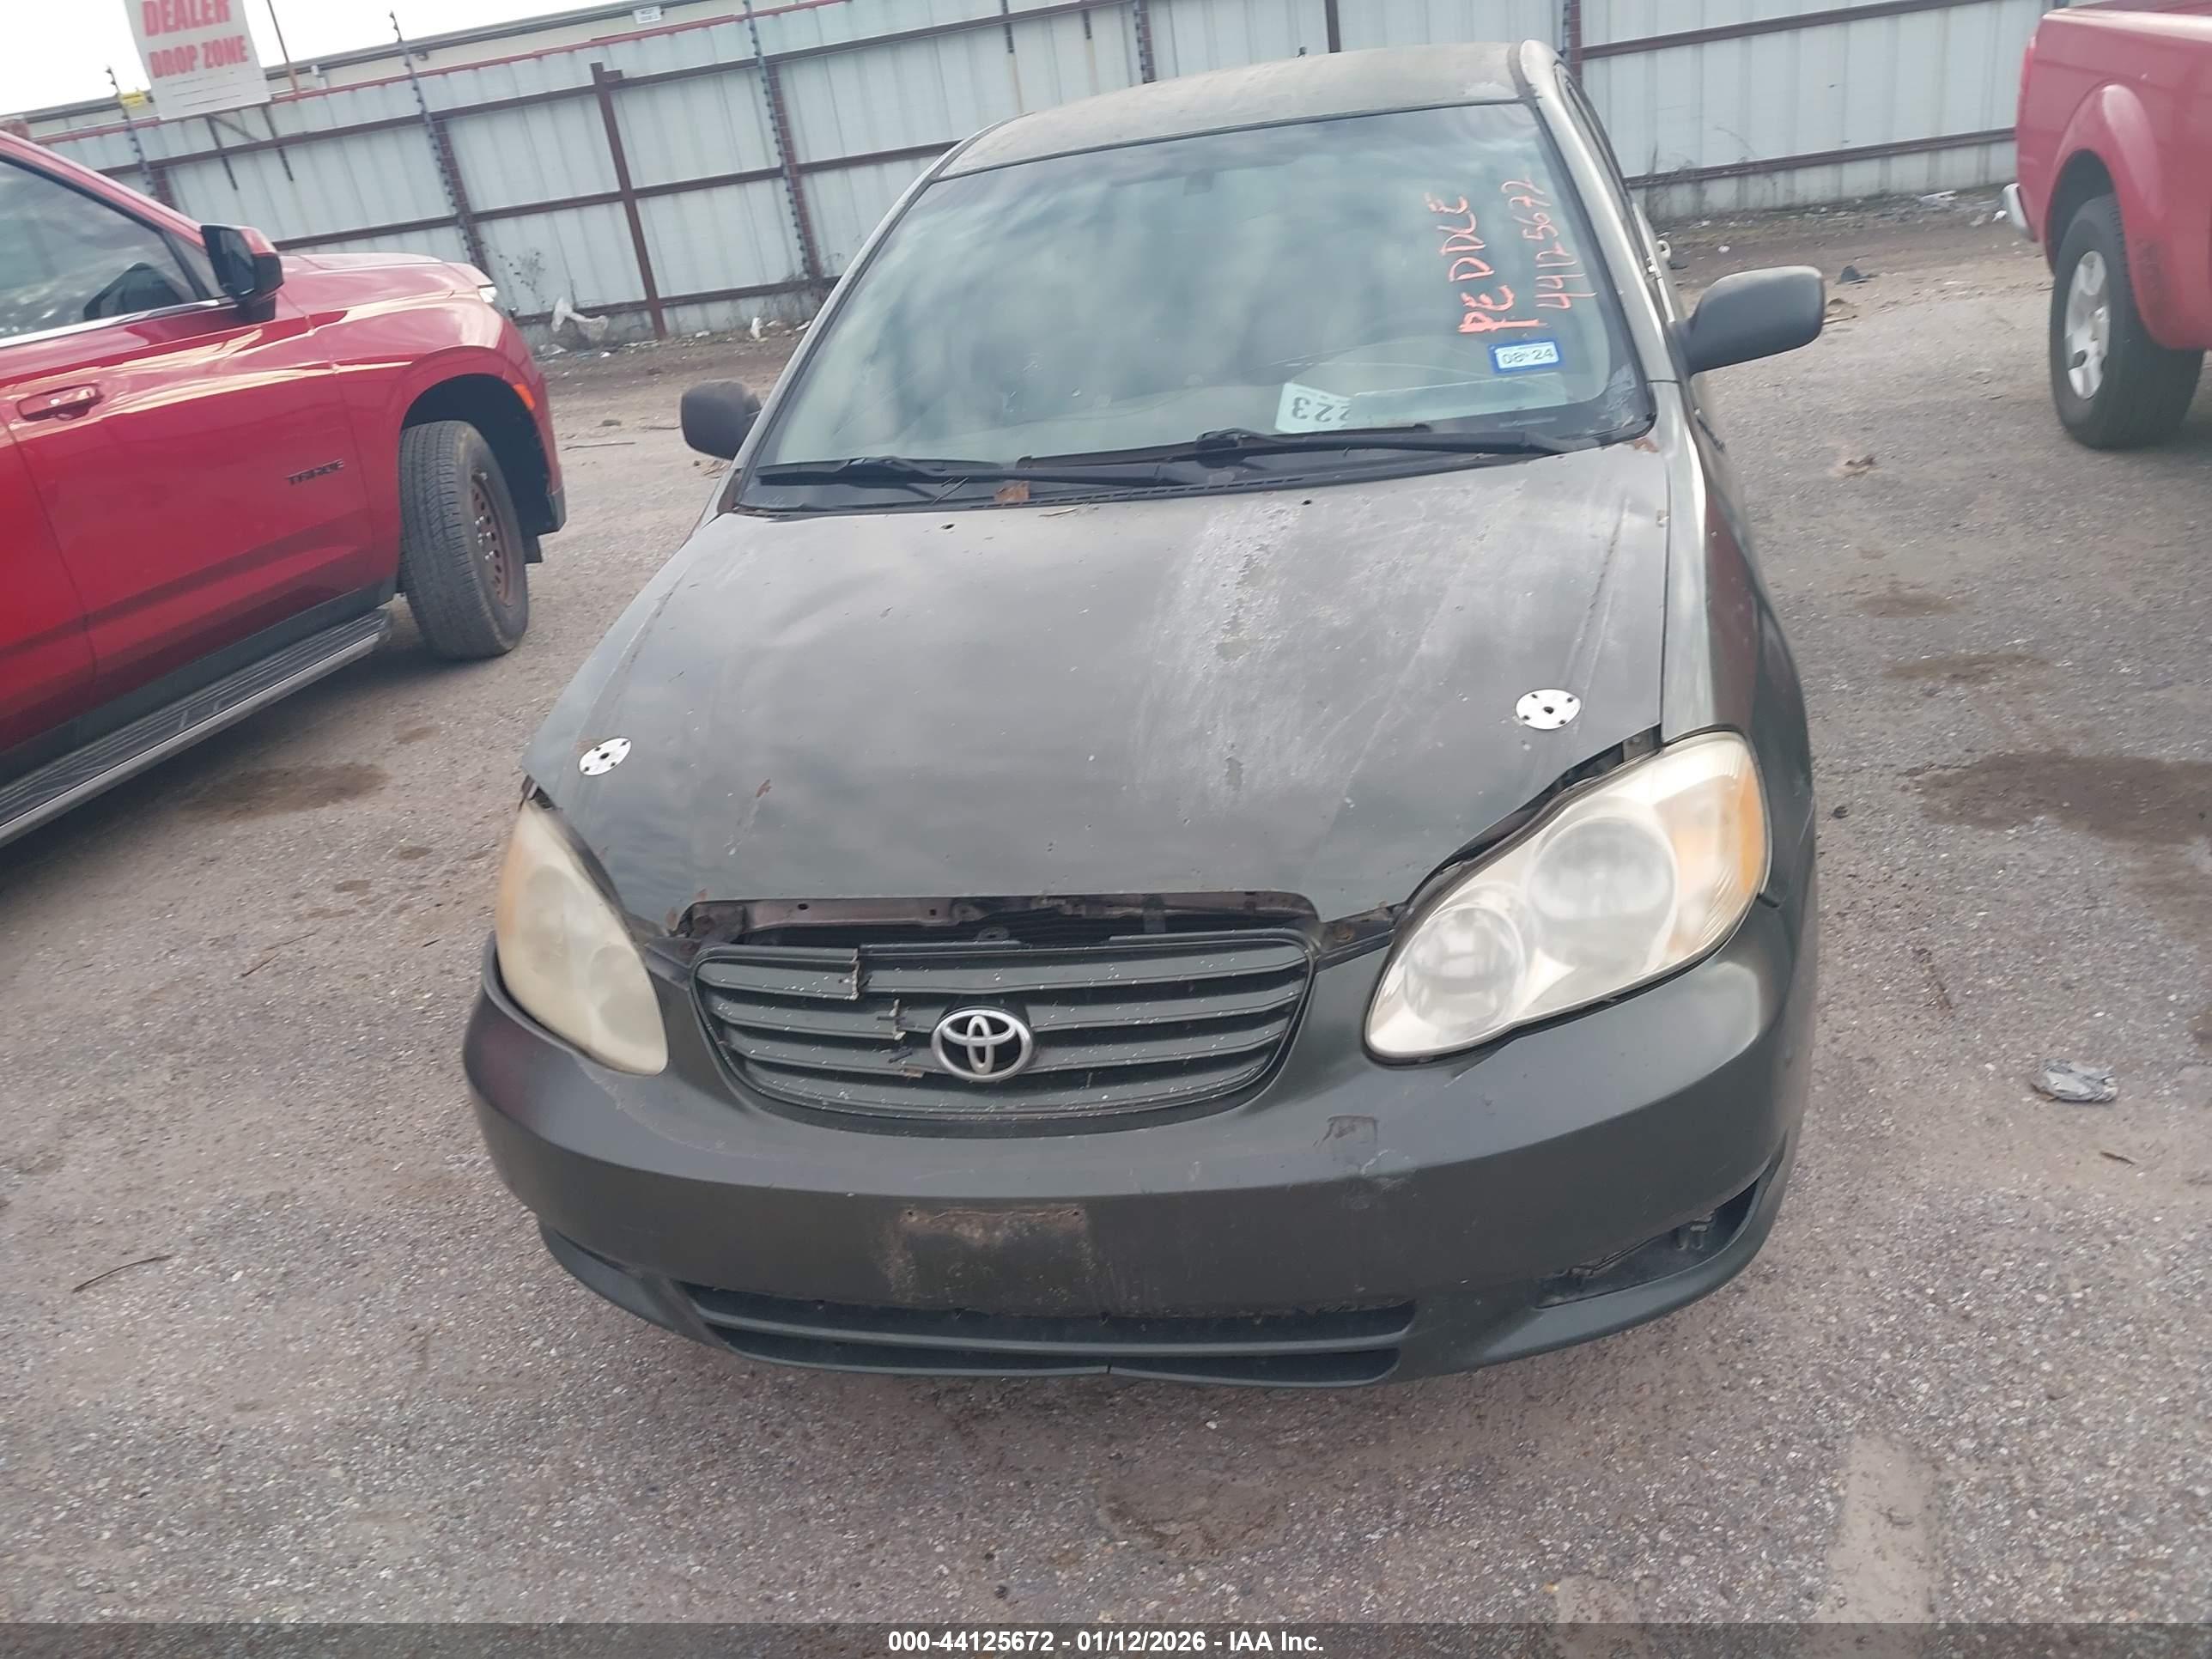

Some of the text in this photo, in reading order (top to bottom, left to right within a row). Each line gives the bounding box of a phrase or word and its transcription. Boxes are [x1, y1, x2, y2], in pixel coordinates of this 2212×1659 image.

[142, 0, 231, 36] DEALER
[149, 35, 248, 78] DROP ZONE
